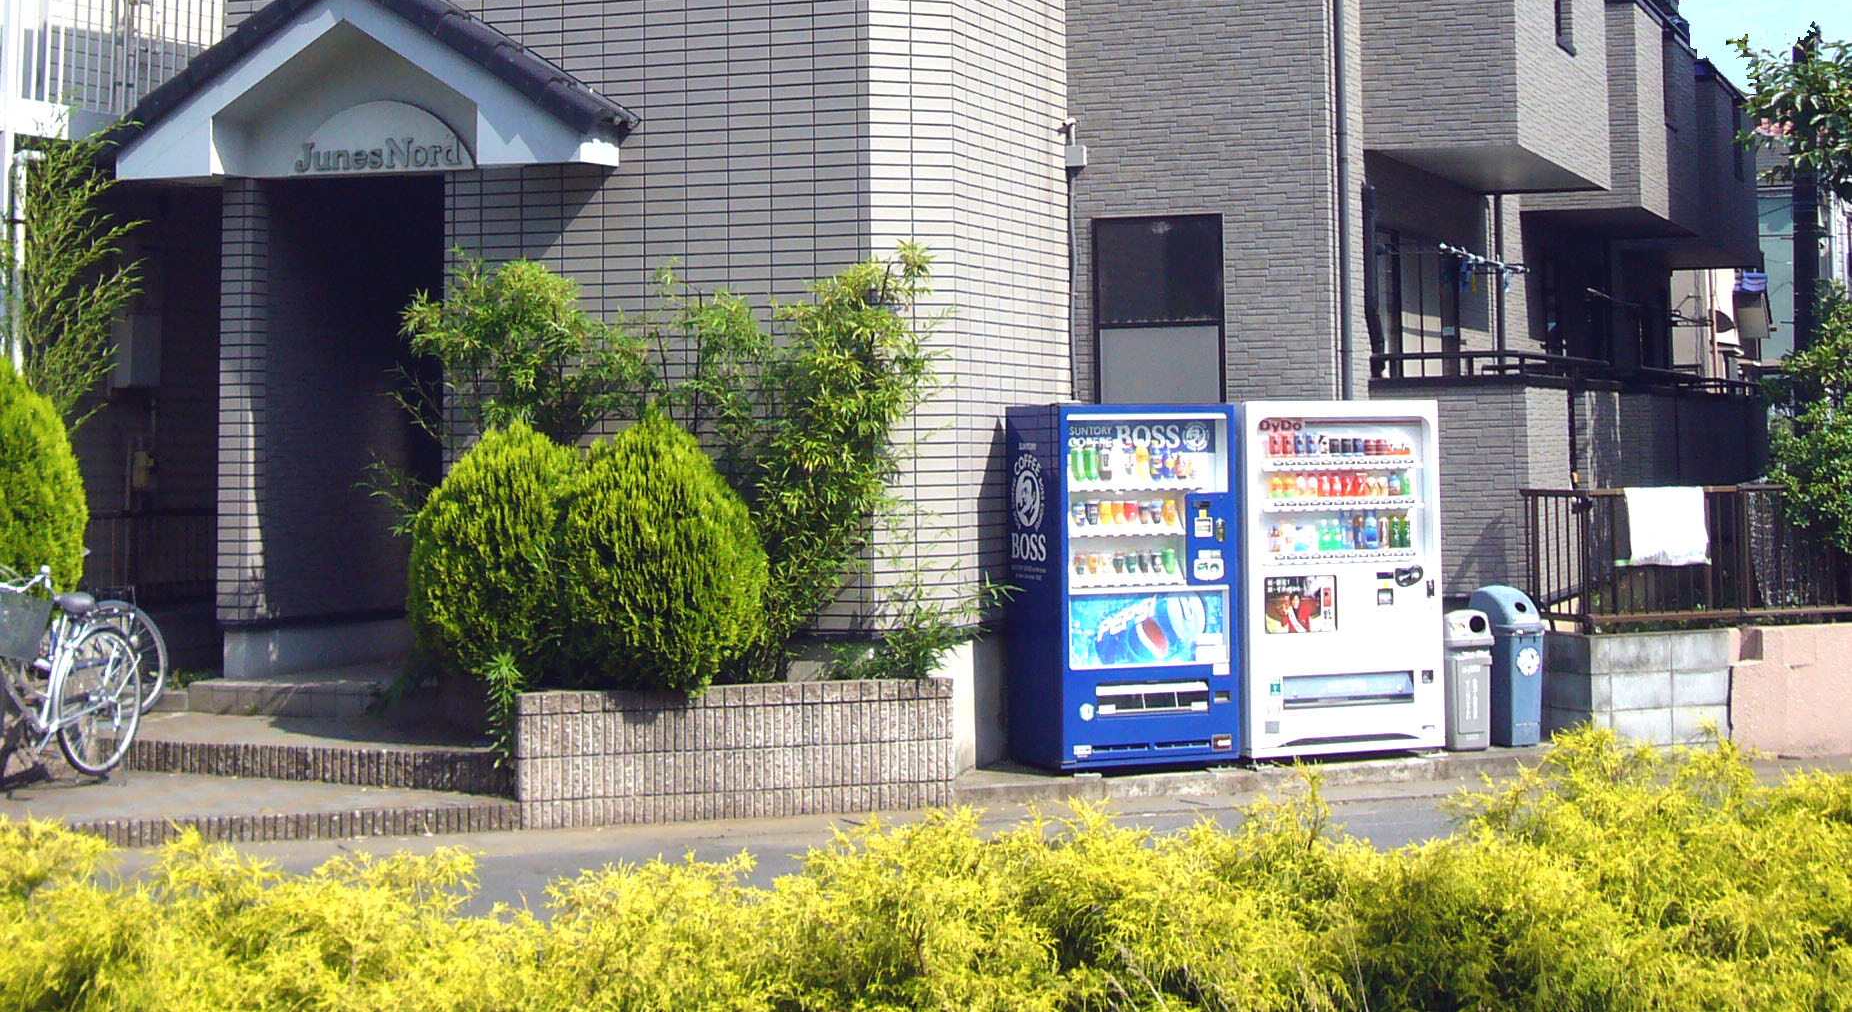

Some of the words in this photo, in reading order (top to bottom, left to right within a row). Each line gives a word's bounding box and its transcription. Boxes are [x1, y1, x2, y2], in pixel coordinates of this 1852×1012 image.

[1069, 426, 1112, 436] SUNTORY
[1115, 424, 1182, 450] BOSS
[1258, 419, 1303, 433] DyDo
[1013, 453, 1042, 477] COFFEE
[1011, 532, 1047, 562] BOSS
[1096, 594, 1158, 643] PEPSI
